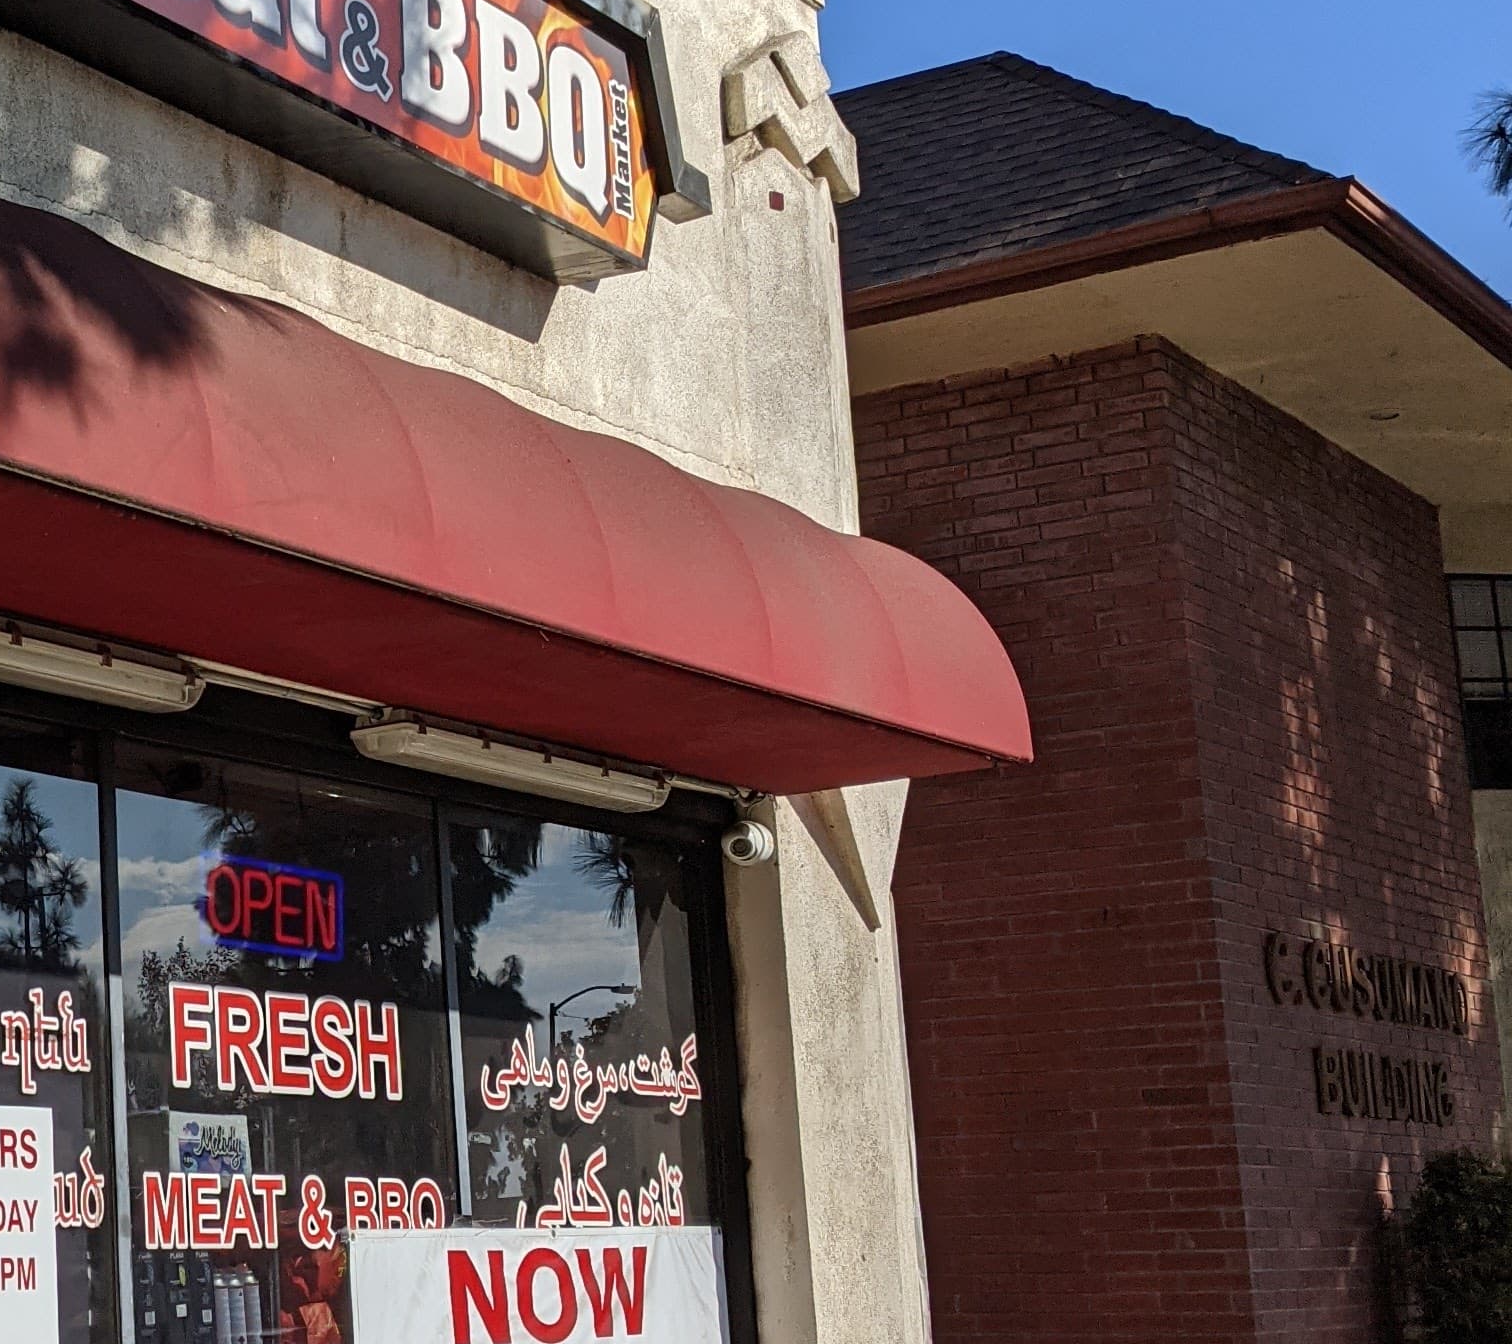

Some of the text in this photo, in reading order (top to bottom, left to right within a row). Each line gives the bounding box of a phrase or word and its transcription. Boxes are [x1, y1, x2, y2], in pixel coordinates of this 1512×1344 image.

[608, 79, 635, 222] Market
[205, 862, 337, 952] OPEN
[169, 981, 403, 1101] FRESH
[1312, 1045, 1455, 1127] BUILDING
[142, 1170, 287, 1250] MEAT
[299, 1174, 336, 1251] &
[345, 1177, 446, 1230] BBQ
[1, 1258, 37, 1291] PM
